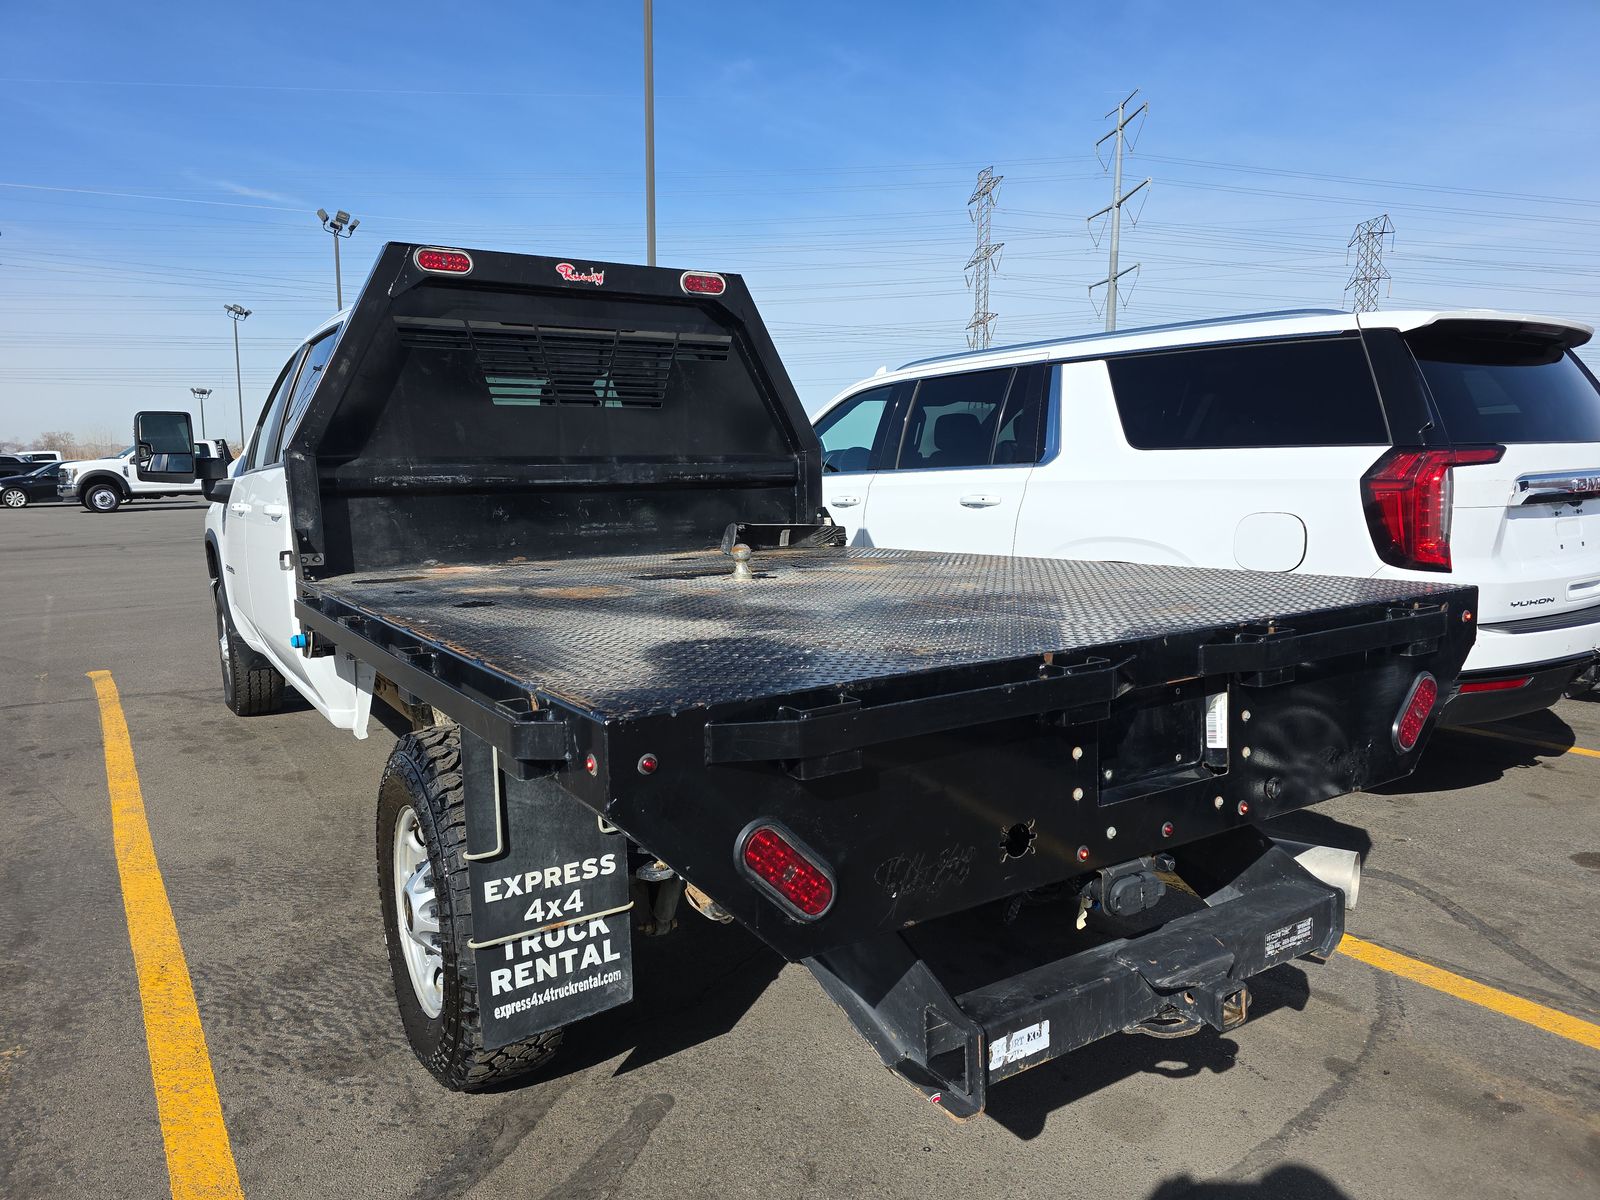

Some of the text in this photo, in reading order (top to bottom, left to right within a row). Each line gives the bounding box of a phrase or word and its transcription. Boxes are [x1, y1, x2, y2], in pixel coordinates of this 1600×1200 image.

[1570, 477, 1600, 492] GM
[1510, 597, 1555, 607] YUKON
[483, 854, 617, 903] EXPRESS
[524, 889, 584, 923] 4x4
[503, 916, 610, 961] TRUCK
[490, 939, 621, 996] RENTAL
[494, 969, 622, 1020] express4x4truckrental.com
